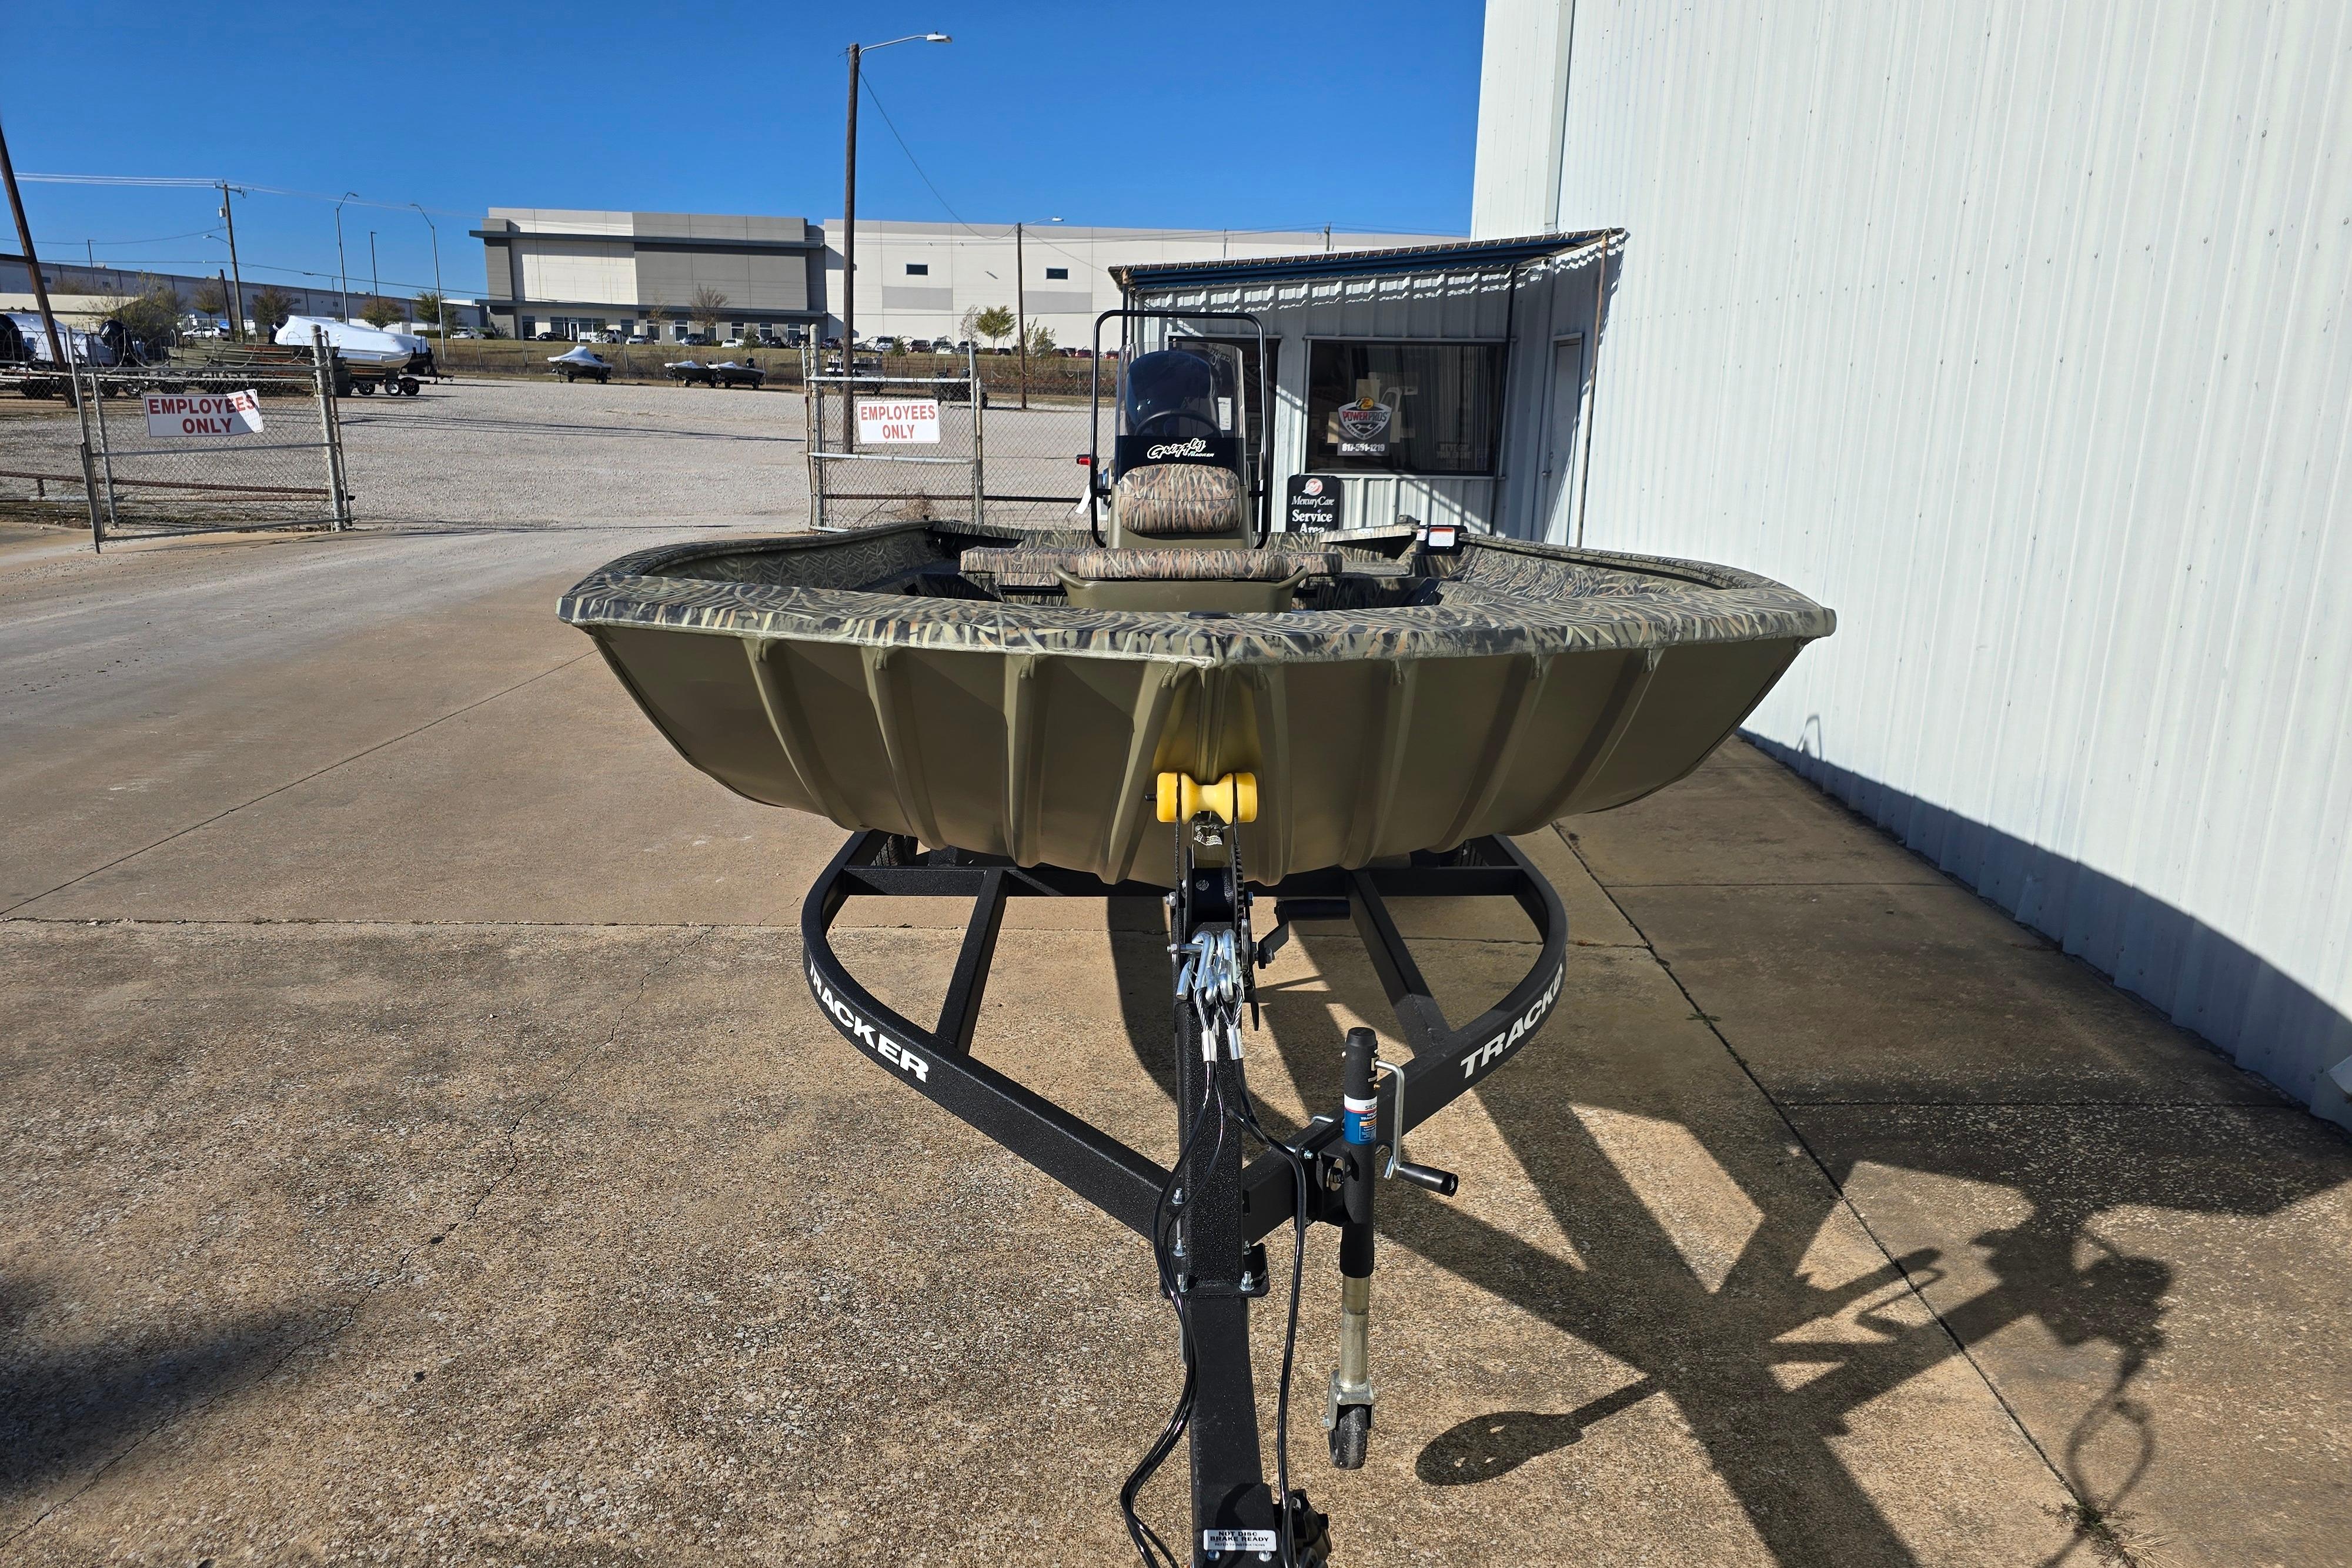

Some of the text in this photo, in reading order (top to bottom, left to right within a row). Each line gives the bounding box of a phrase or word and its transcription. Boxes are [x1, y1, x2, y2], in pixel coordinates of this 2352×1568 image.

[148, 394, 257, 414] EMPLOYEES
[861, 404, 936, 420] EMPLOYEES
[182, 417, 232, 434] ONLY
[883, 424, 914, 439] ONLY
[1292, 509, 1333, 522] Service
[809, 954, 929, 1083] TRACKER
